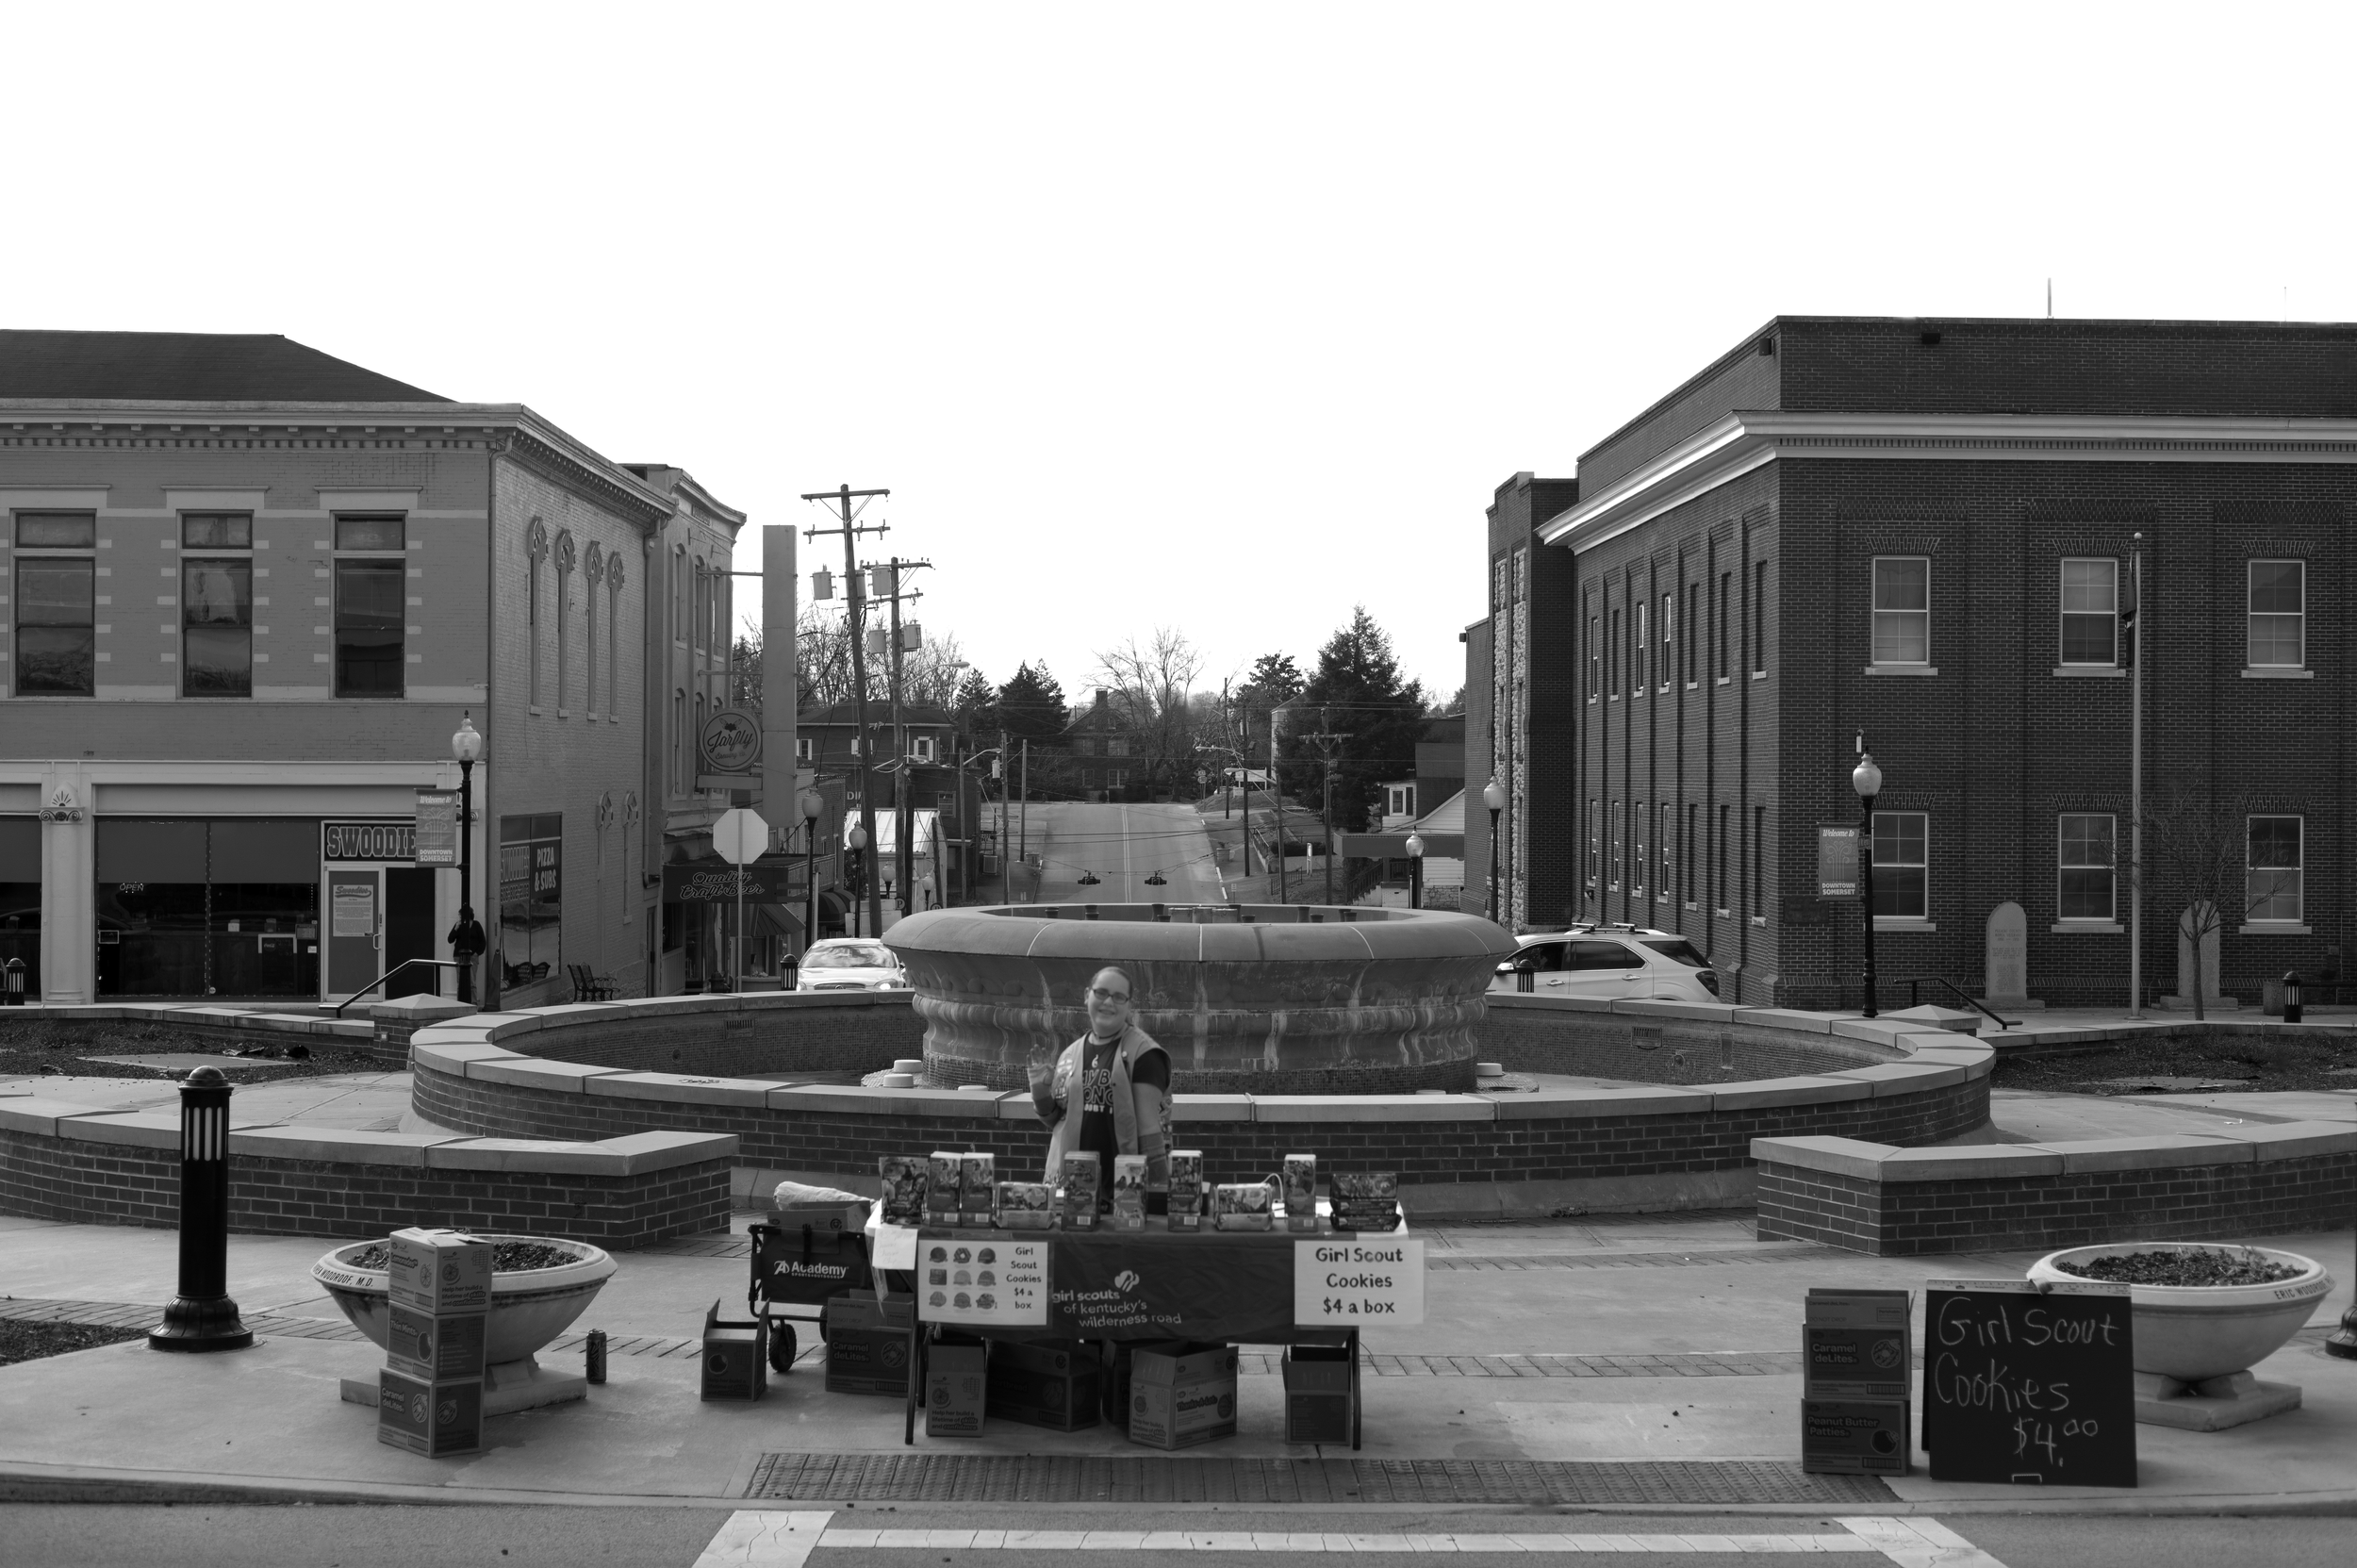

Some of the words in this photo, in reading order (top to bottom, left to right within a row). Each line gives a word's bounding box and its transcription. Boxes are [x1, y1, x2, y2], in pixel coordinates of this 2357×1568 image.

[707, 730, 753, 753] Jarfly
[420, 796, 445, 804] Welcome
[1822, 829, 1848, 837] Welcome
[1848, 829, 1854, 837] to
[536, 847, 555, 867] PIZZA
[119, 883, 144, 891] OPEN
[535, 871, 540, 892] &
[540, 868, 556, 891] SUBS
[680, 884, 723, 900] Craft
[723, 882, 765, 897] Beer
[1015, 1246, 1034, 1256] Girl
[1315, 1247, 1348, 1263] Girl
[1353, 1247, 1403, 1263] Scout
[791, 1261, 847, 1279] Academy
[1011, 1261, 1037, 1270] Scout
[355, 1277, 373, 1287] M.D.
[1006, 1274, 1042, 1283] Cookies
[1326, 1273, 1393, 1288] Cookies
[1014, 1287, 1025, 1297] $4
[1052, 1290, 1075, 1303] girl
[1077, 1288, 1120, 1301] scouts
[2274, 1289, 2296, 1299] ERIC
[1014, 1300, 1032, 1310] box
[1063, 1303, 1077, 1314] of
[1080, 1299, 1147, 1314] kentucky's
[1323, 1296, 1343, 1315] $4
[1348, 1304, 1359, 1313] a
[1364, 1299, 1395, 1314] box
[1078, 1313, 1147, 1329] wilderness
[1151, 1312, 1182, 1324] road
[1938, 1296, 2012, 1346] Girl
[2020, 1308, 2120, 1346] Scout
[832, 1342, 869, 1352] Caramel
[1812, 1343, 1856, 1353] Caramel
[1935, 1352, 2069, 1412] Cookies
[381, 1387, 404, 1402] Caramel
[1807, 1415, 1842, 1426] Peanut
[1845, 1417, 1879, 1428] Butter
[1809, 1427, 1845, 1437] Patties
